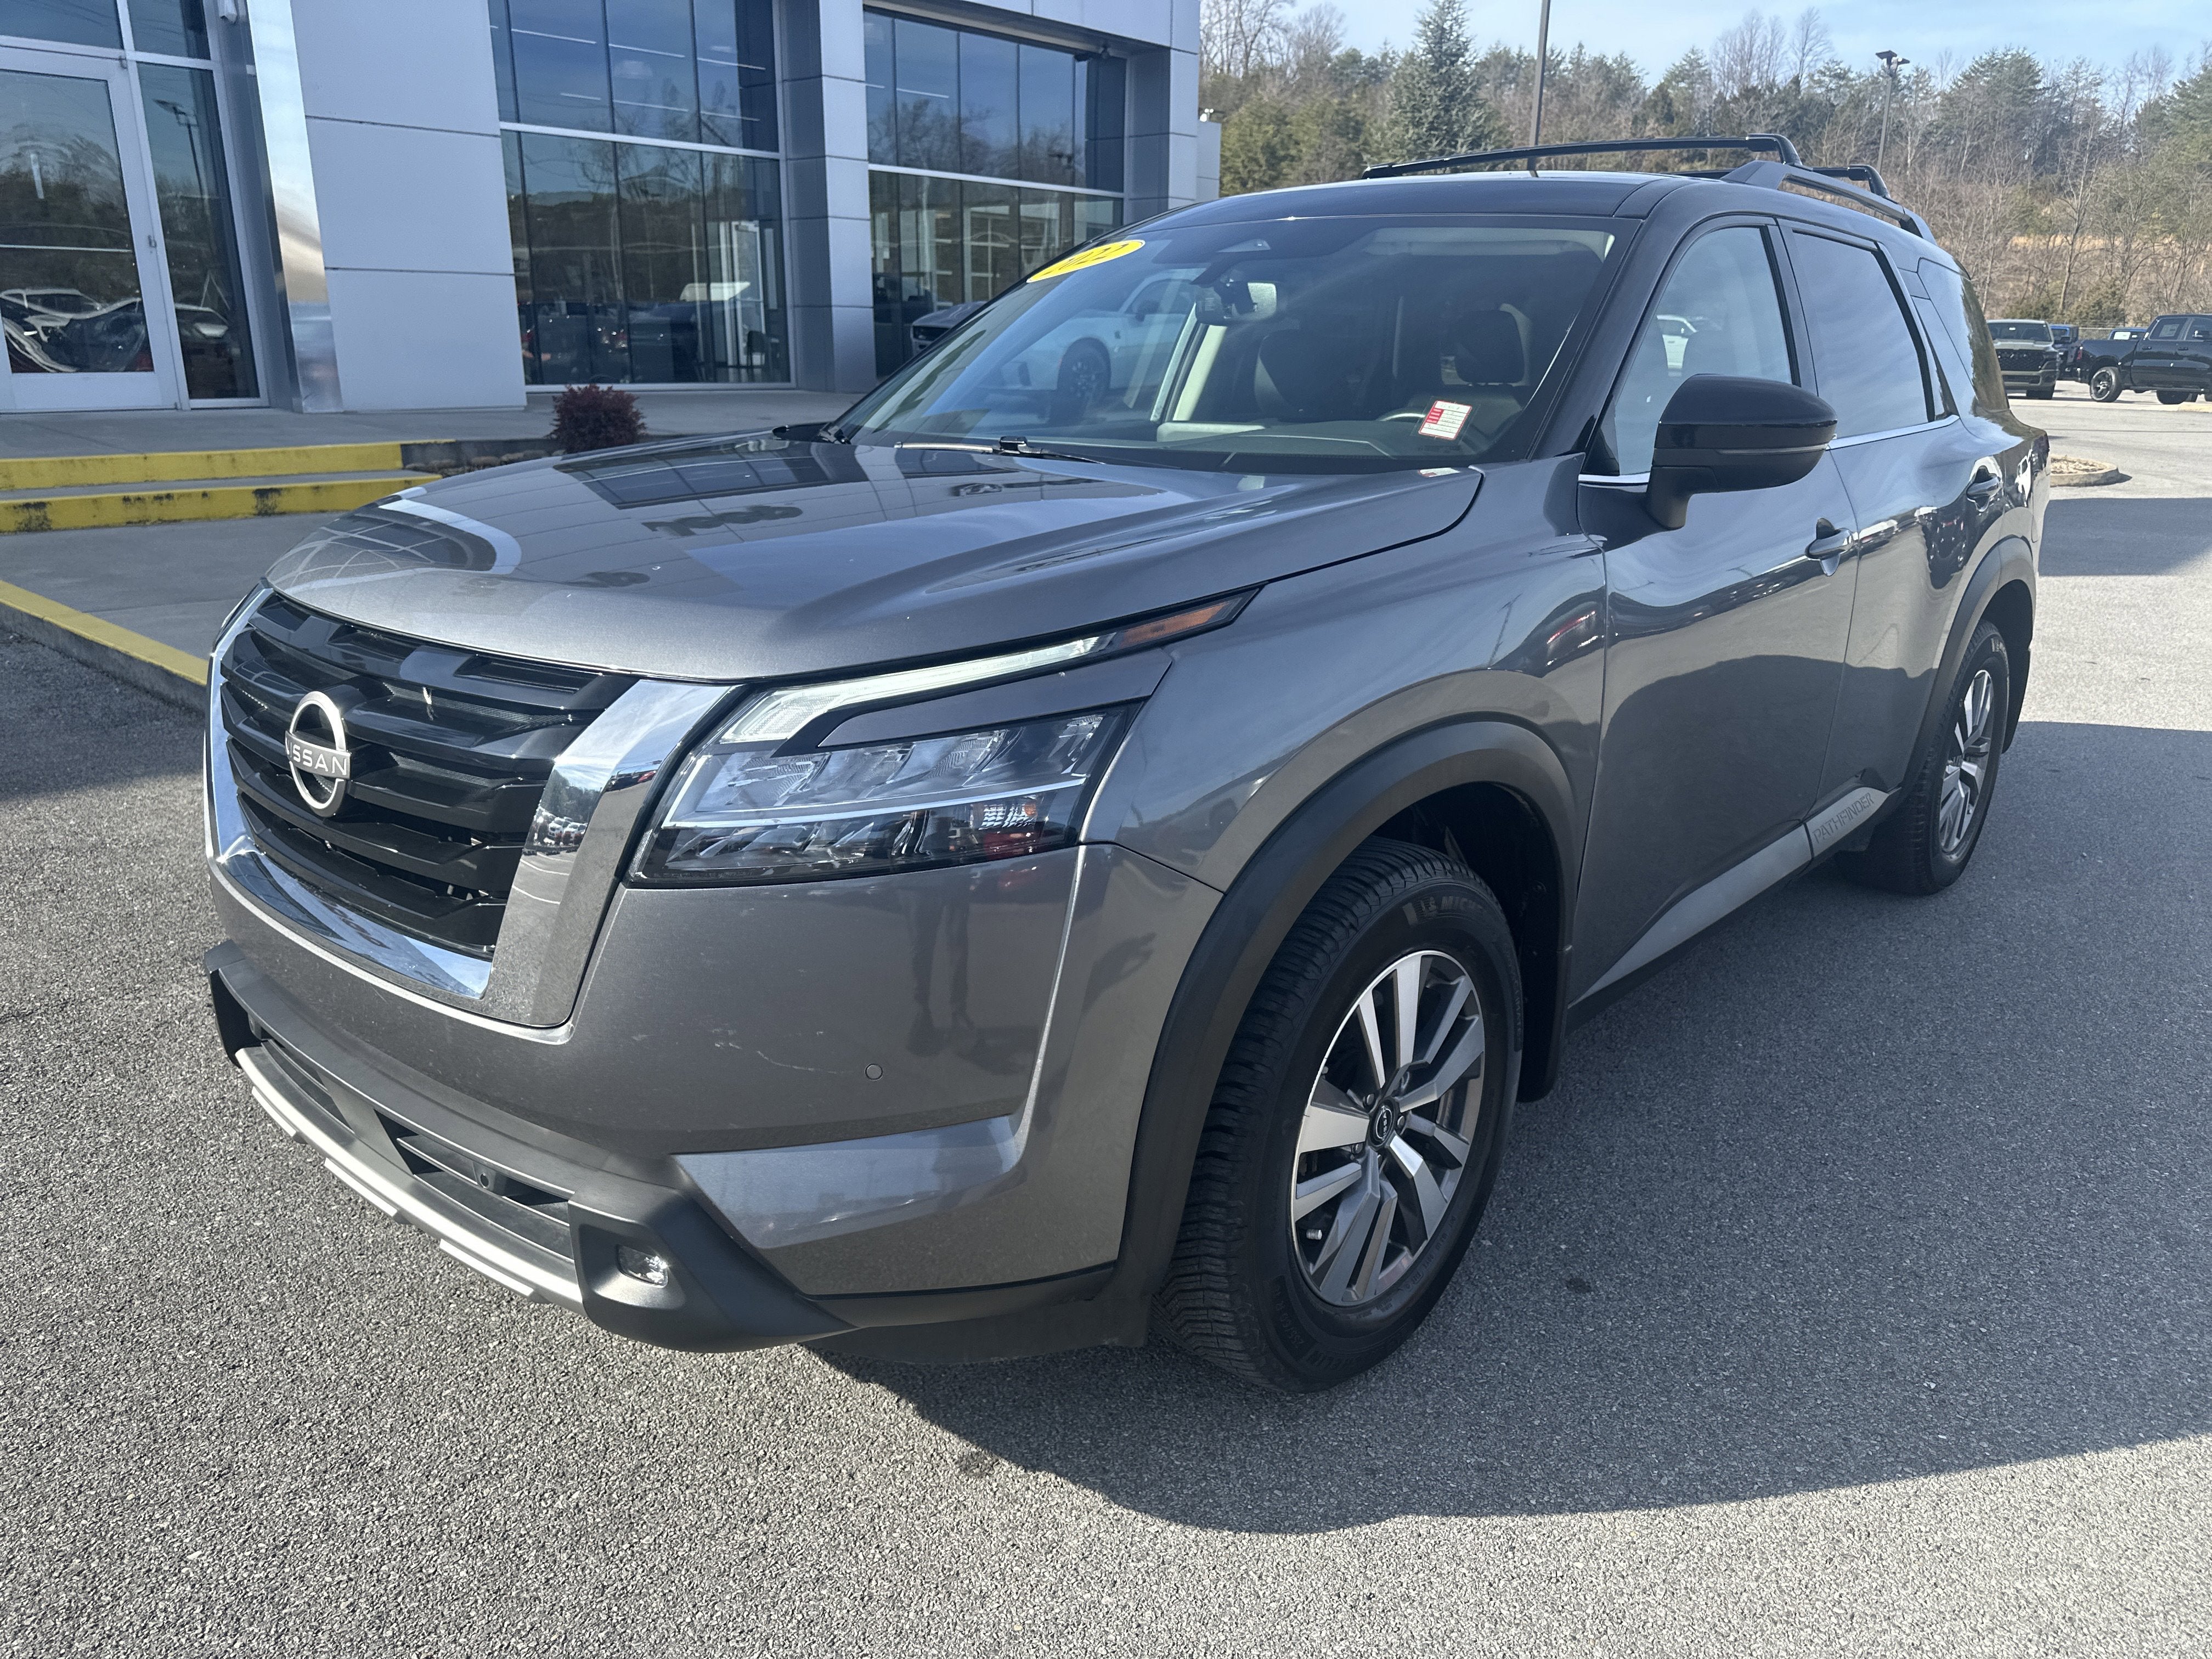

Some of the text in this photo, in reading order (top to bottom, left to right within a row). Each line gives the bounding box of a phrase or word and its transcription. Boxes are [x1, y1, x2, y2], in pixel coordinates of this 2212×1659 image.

[1042, 242, 1130, 276] 2022
[285, 737, 347, 776] NISSAN
[1812, 792, 1875, 844] PATHFINDER
